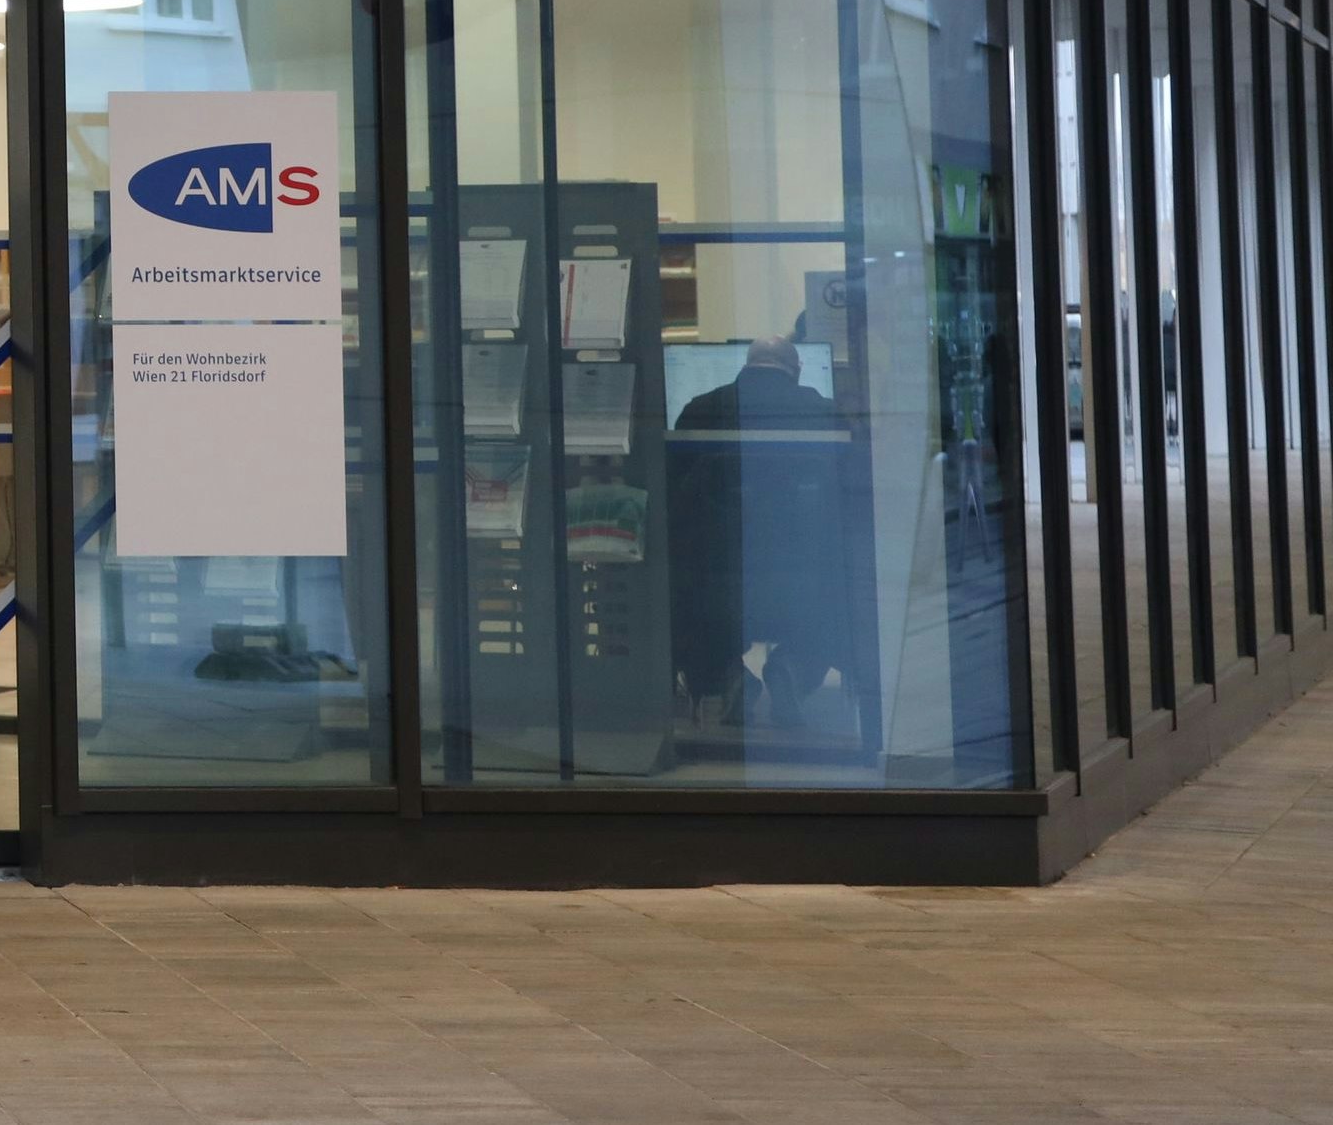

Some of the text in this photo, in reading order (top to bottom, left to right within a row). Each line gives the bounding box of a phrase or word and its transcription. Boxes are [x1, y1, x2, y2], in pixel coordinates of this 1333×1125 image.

[174, 166, 321, 207] AMS
[131, 266, 322, 284] Arbeitsmarktservice
[132, 352, 267, 366] Für den Wohnbezirk
[132, 369, 266, 383] Wien 21 Floridsdorf
